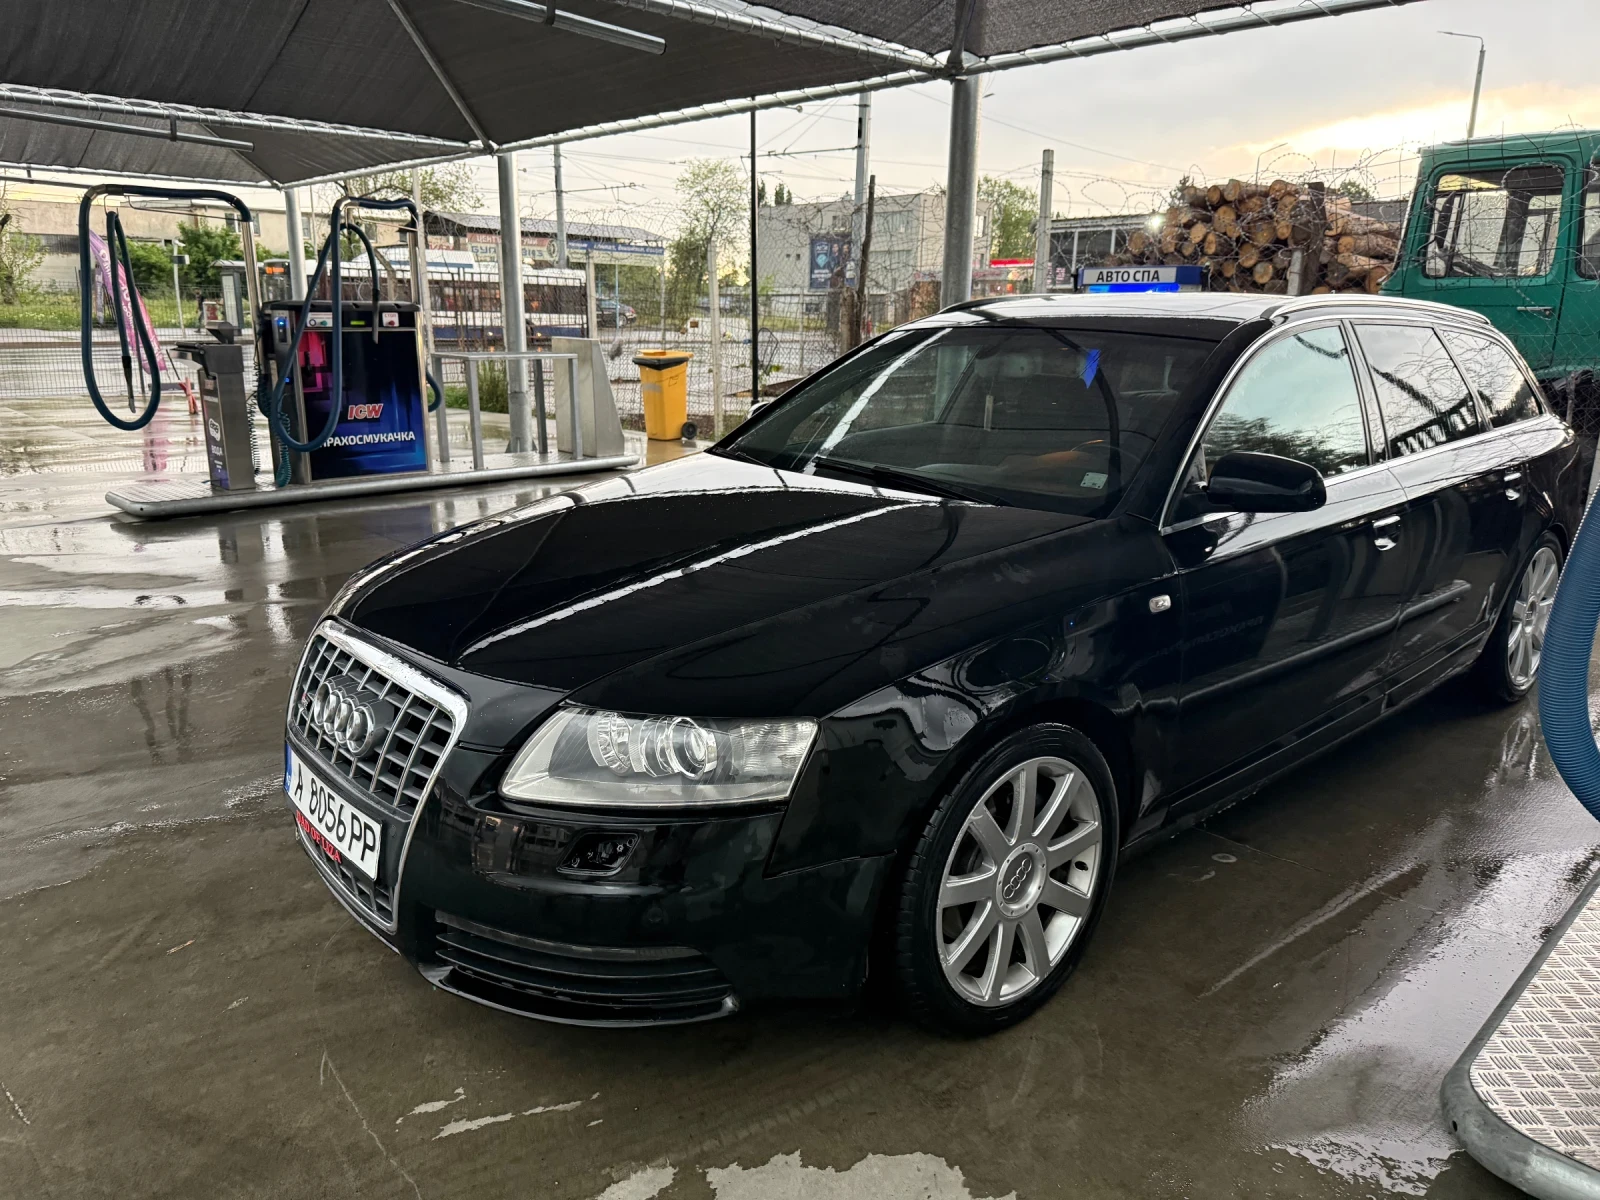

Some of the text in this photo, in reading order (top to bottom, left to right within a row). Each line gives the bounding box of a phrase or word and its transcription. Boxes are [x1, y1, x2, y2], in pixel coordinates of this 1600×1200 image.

[1096, 269, 1160, 283] АВТО СПА
[347, 403, 384, 420] ICW
[296, 809, 342, 864] DAD OF LIZA
[309, 777, 347, 843] 8056
[347, 811, 377, 862] PP
